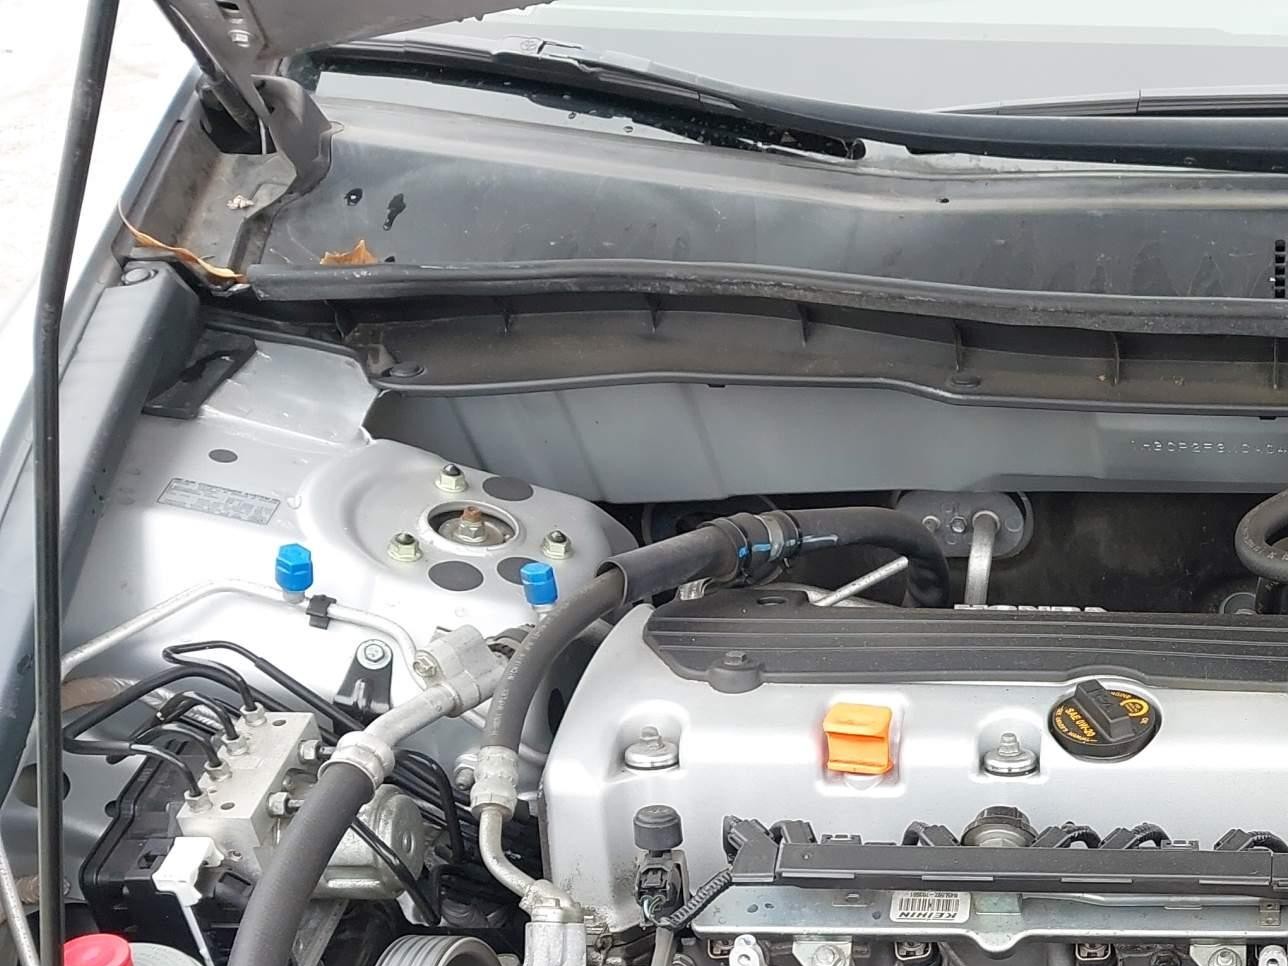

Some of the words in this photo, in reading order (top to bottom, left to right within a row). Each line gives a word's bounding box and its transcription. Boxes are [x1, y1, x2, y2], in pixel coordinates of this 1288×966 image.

[1064, 707, 1083, 721] SAE
[1075, 719, 1097, 737] 0W-20
[898, 911, 958, 919] KEIHIN
